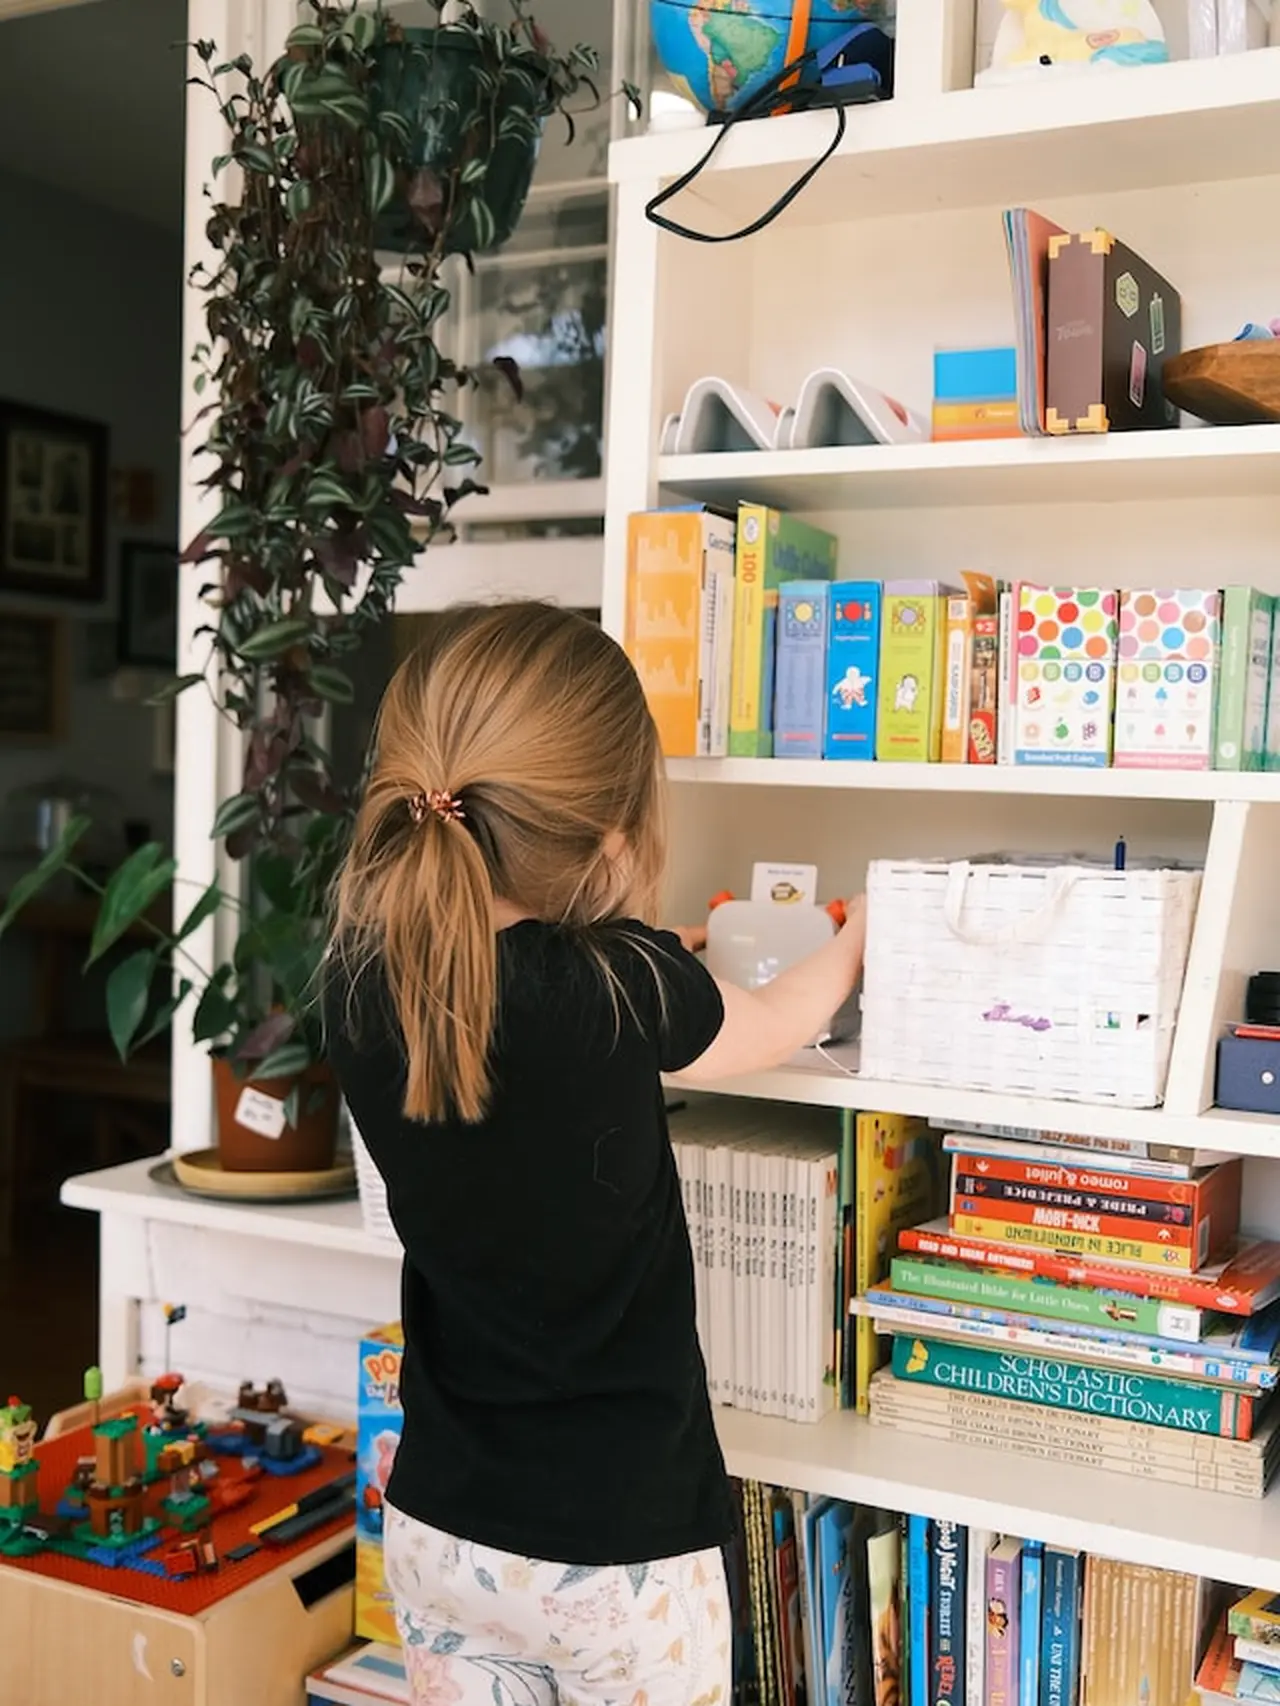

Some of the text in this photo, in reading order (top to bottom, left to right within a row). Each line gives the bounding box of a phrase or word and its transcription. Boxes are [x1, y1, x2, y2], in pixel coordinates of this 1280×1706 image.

[743, 552, 757, 584] 100
[1024, 1165, 1129, 1192] romeo & juliet
[1003, 1184, 1147, 1216] PRIDE & PREJUDICE
[1032, 1207, 1101, 1232] MOBY-DICK
[901, 1270, 1090, 1313] The Illustrated Bible for Little Ones
[1000, 1354, 1144, 1398] SCHOLASTIC
[934, 1362, 1212, 1431] CHILDREN'S DICTIONARY
[935, 1655, 956, 1698] REBEL
